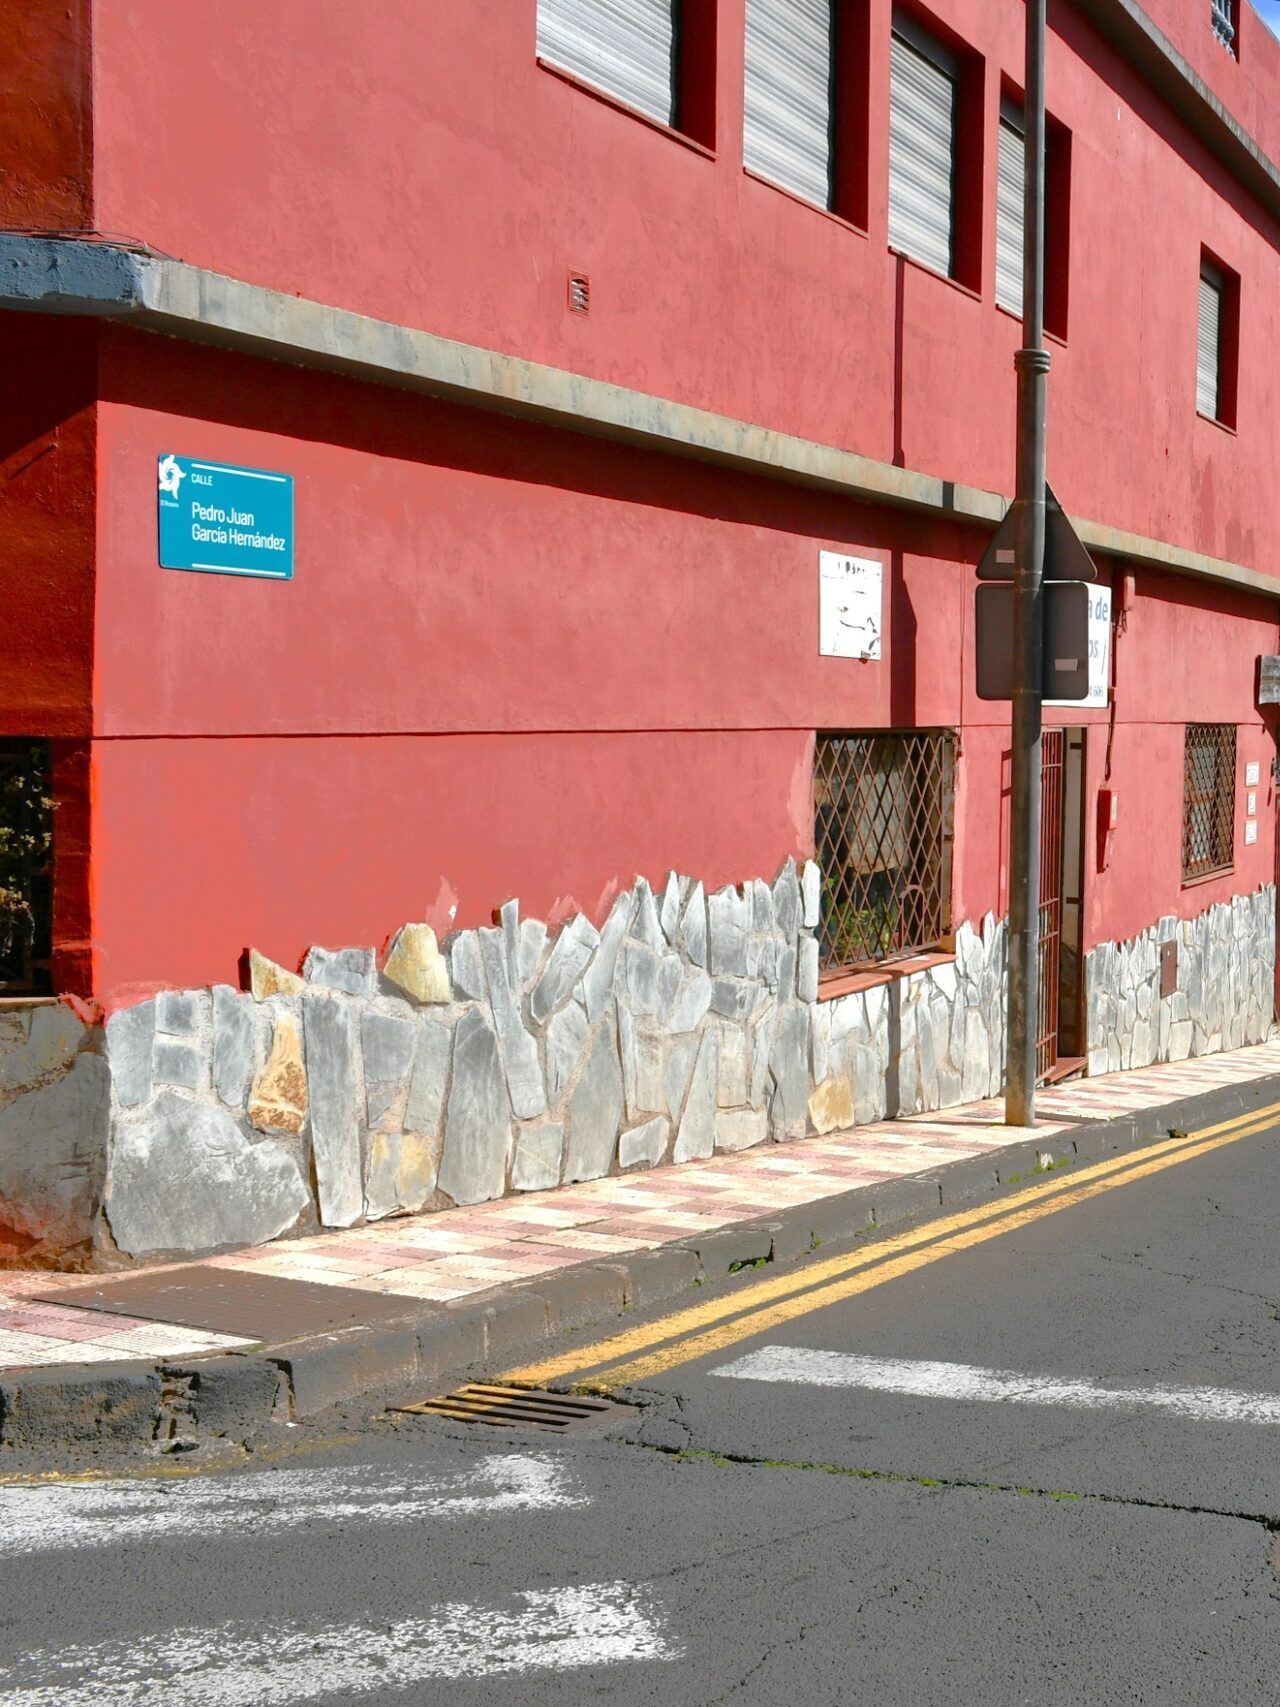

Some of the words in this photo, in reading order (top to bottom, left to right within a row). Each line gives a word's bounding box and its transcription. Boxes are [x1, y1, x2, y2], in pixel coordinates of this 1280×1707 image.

[191, 473, 213, 486] CALLE
[191, 501, 225, 523] Pedro
[226, 507, 255, 527] Juan
[191, 523, 228, 545] García
[229, 528, 286, 551] Hernández
[1095, 596, 1108, 622] de
